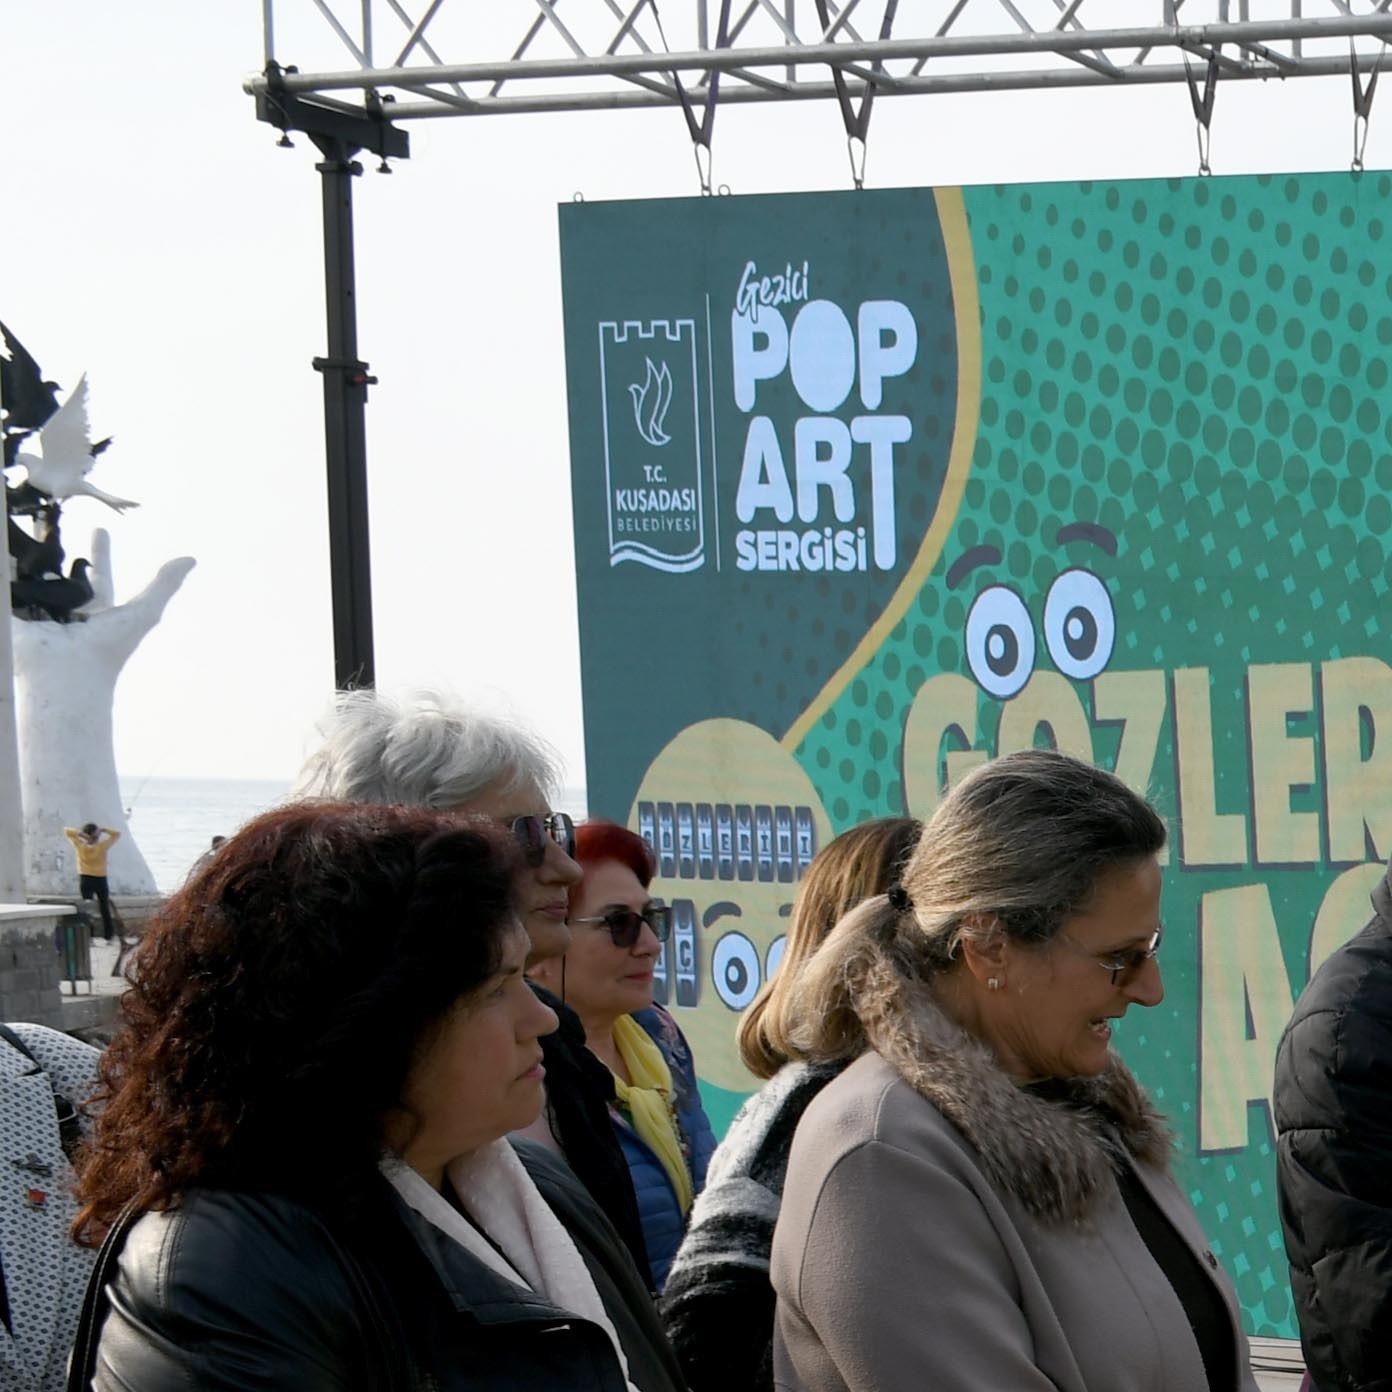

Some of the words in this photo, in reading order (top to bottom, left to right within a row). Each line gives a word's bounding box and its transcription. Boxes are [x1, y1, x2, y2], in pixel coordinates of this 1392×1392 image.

[736, 260, 809, 322] Gezici
[731, 299, 918, 412] POP
[643, 465, 667, 483] T.C.
[735, 415, 912, 571] ART
[616, 488, 696, 513] KUŞADASI
[617, 515, 697, 532] BELEDİYESİ
